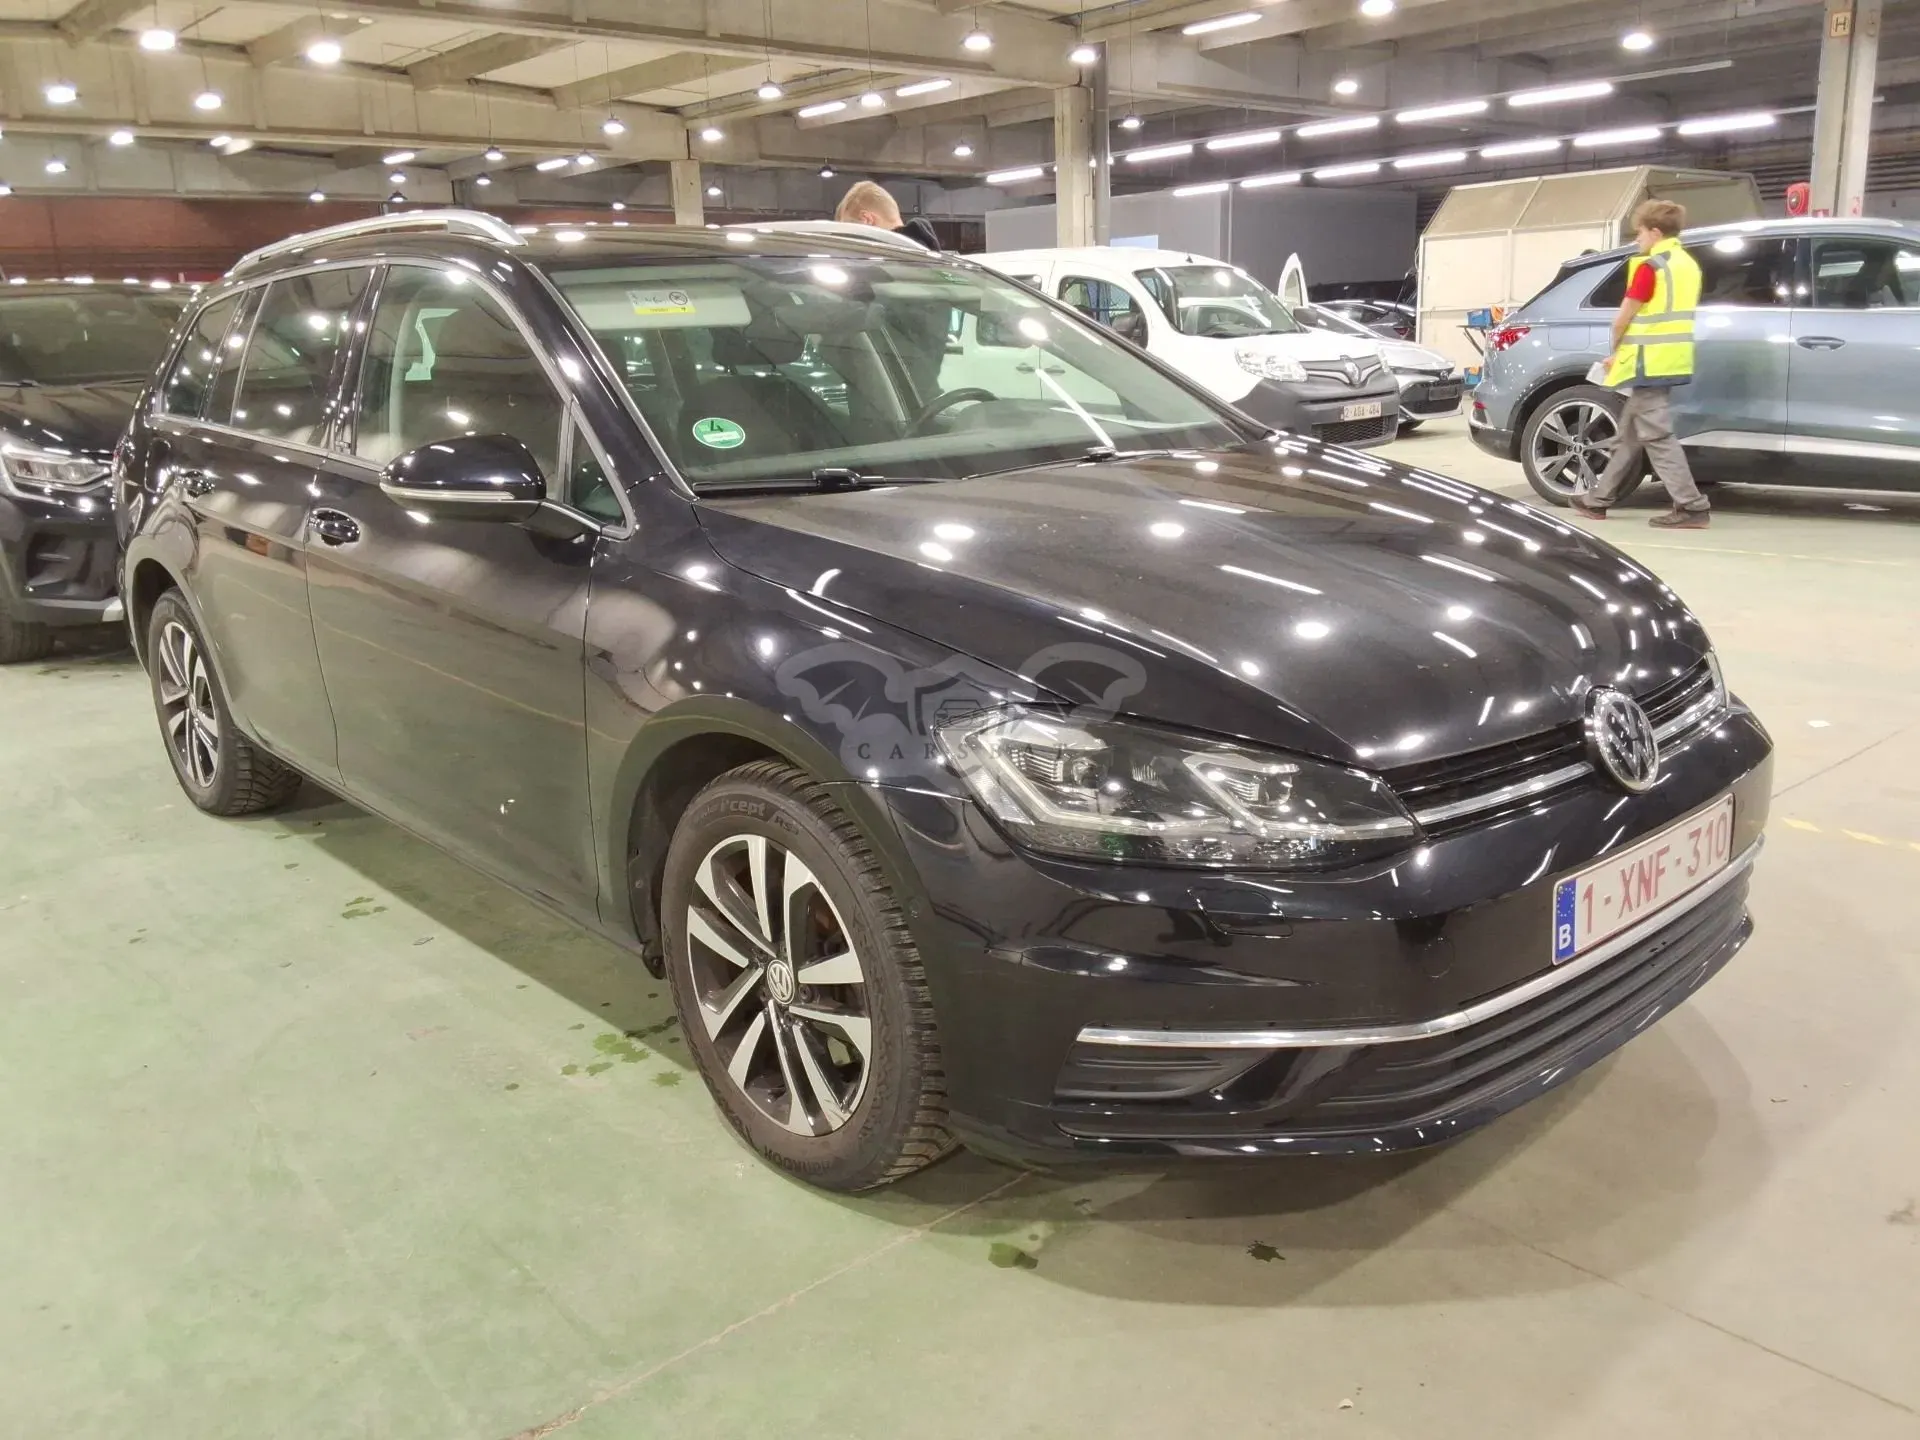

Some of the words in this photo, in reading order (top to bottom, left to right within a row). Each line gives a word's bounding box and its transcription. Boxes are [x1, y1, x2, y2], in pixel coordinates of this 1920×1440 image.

[1834, 15, 1847, 33] H
[1582, 811, 1728, 934] 1-XNF-310
[1558, 923, 1571, 950] B
